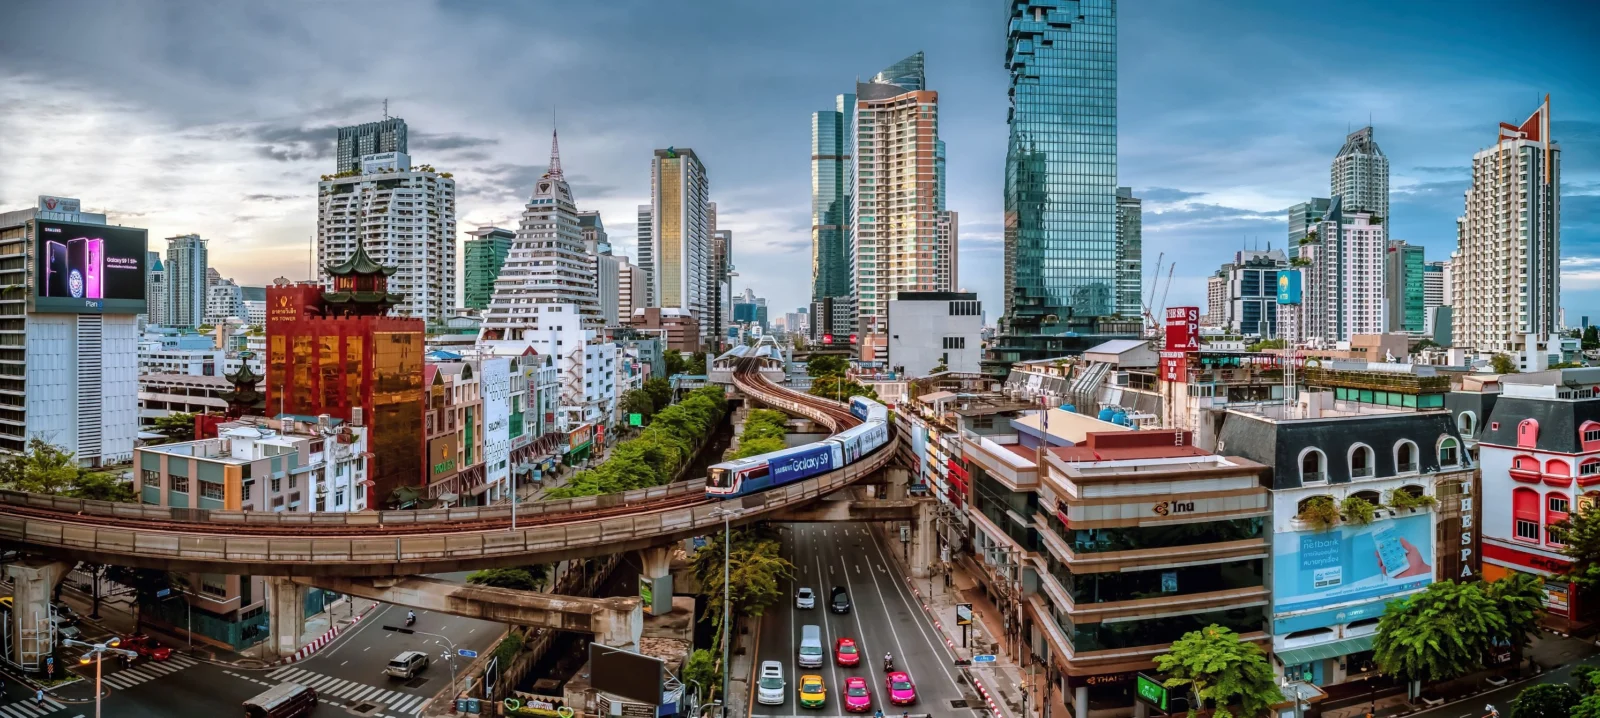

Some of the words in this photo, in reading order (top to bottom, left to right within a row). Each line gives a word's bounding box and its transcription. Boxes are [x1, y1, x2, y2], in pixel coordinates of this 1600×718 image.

[1166, 308, 1177, 319] THE
[1187, 309, 1198, 348] SPA
[488, 420, 501, 432] SILOM
[433, 458, 455, 475] ROLEX
[792, 456, 820, 472] Galaxy
[819, 452, 829, 465] S9
[1460, 481, 1472, 528] THE
[1303, 538, 1339, 549] netbank
[1460, 532, 1473, 578] SPA
[1141, 688, 1159, 704] Chang
